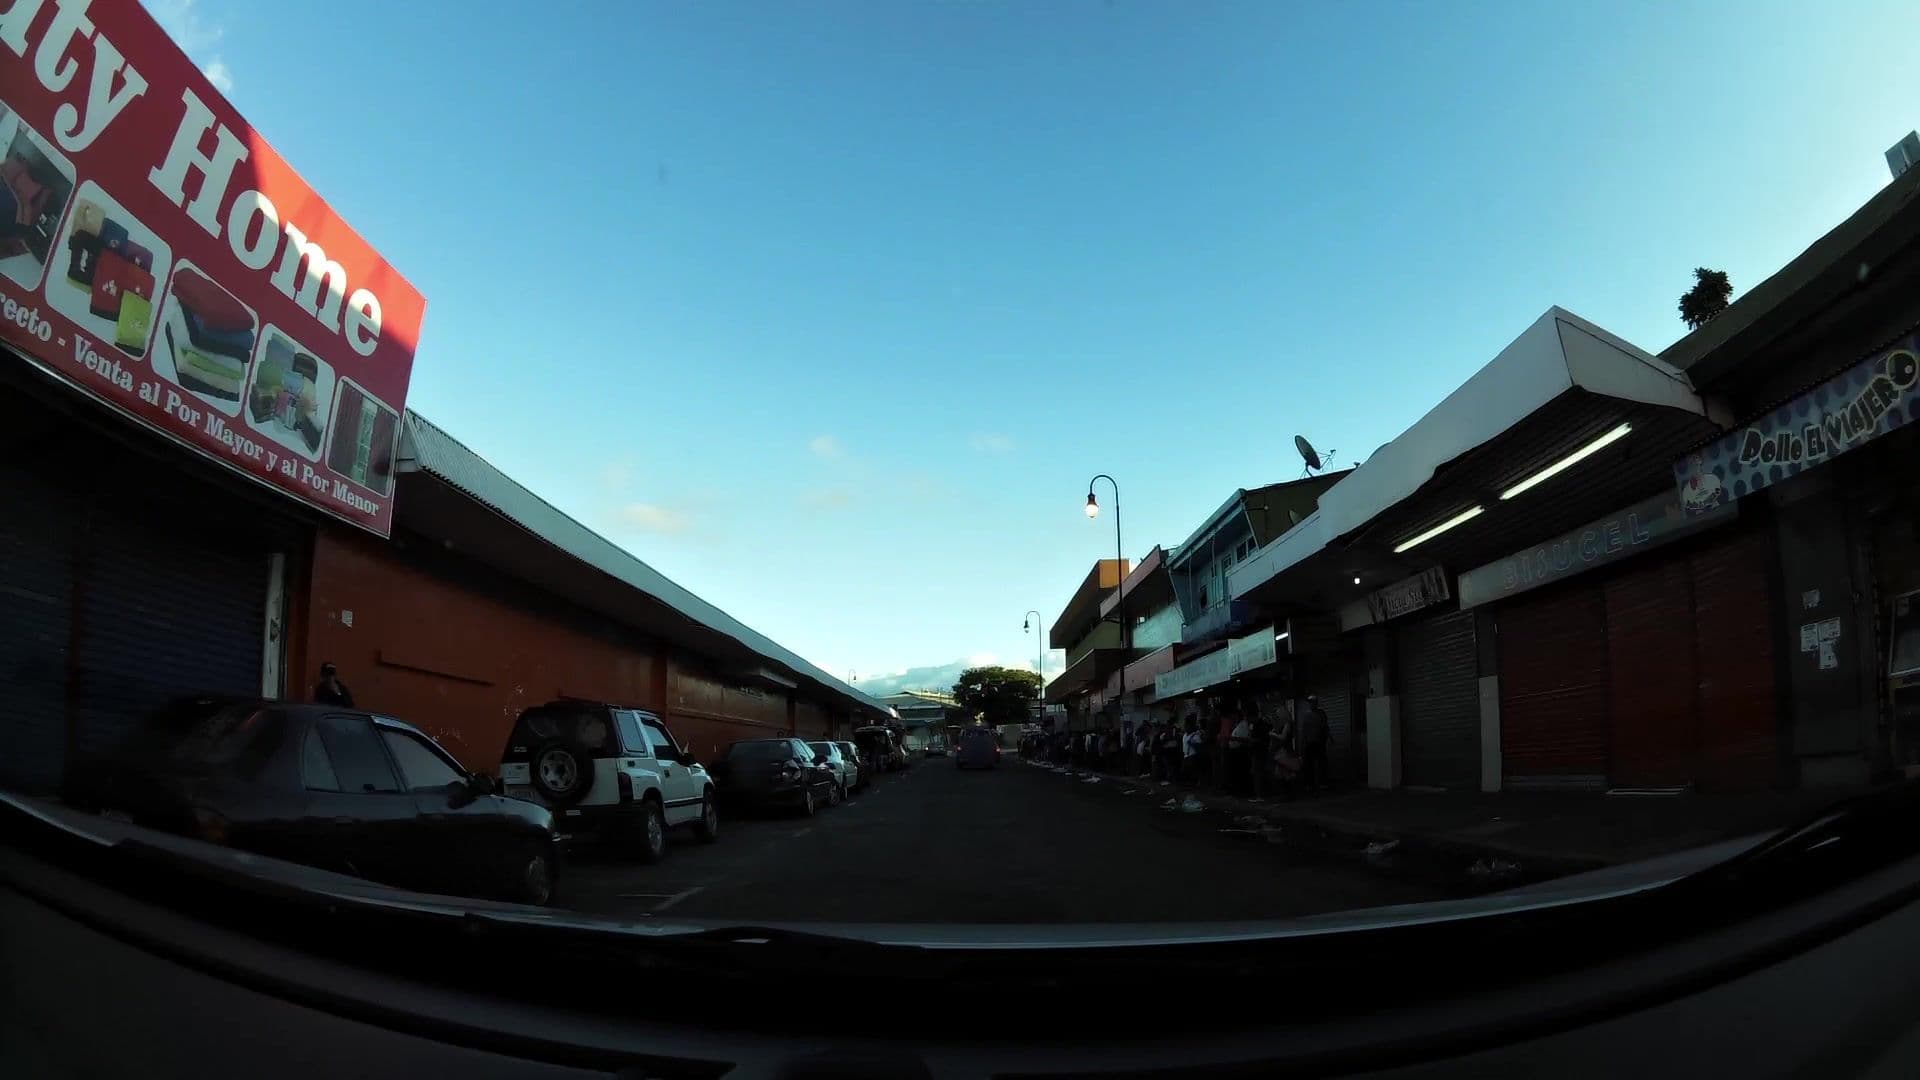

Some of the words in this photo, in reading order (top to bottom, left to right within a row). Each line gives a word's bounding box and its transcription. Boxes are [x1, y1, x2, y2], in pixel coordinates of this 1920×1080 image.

[148, 87, 382, 356] Home
[75, 334, 133, 392] Venta
[140, 382, 161, 406] al
[164, 390, 201, 427] Por
[205, 412, 264, 460] Mayor
[265, 450, 278, 472] y
[281, 457, 298, 480] al
[302, 463, 329, 492] Por
[333, 479, 380, 517] Menor
[1824, 350, 1919, 450] VIAJERO
